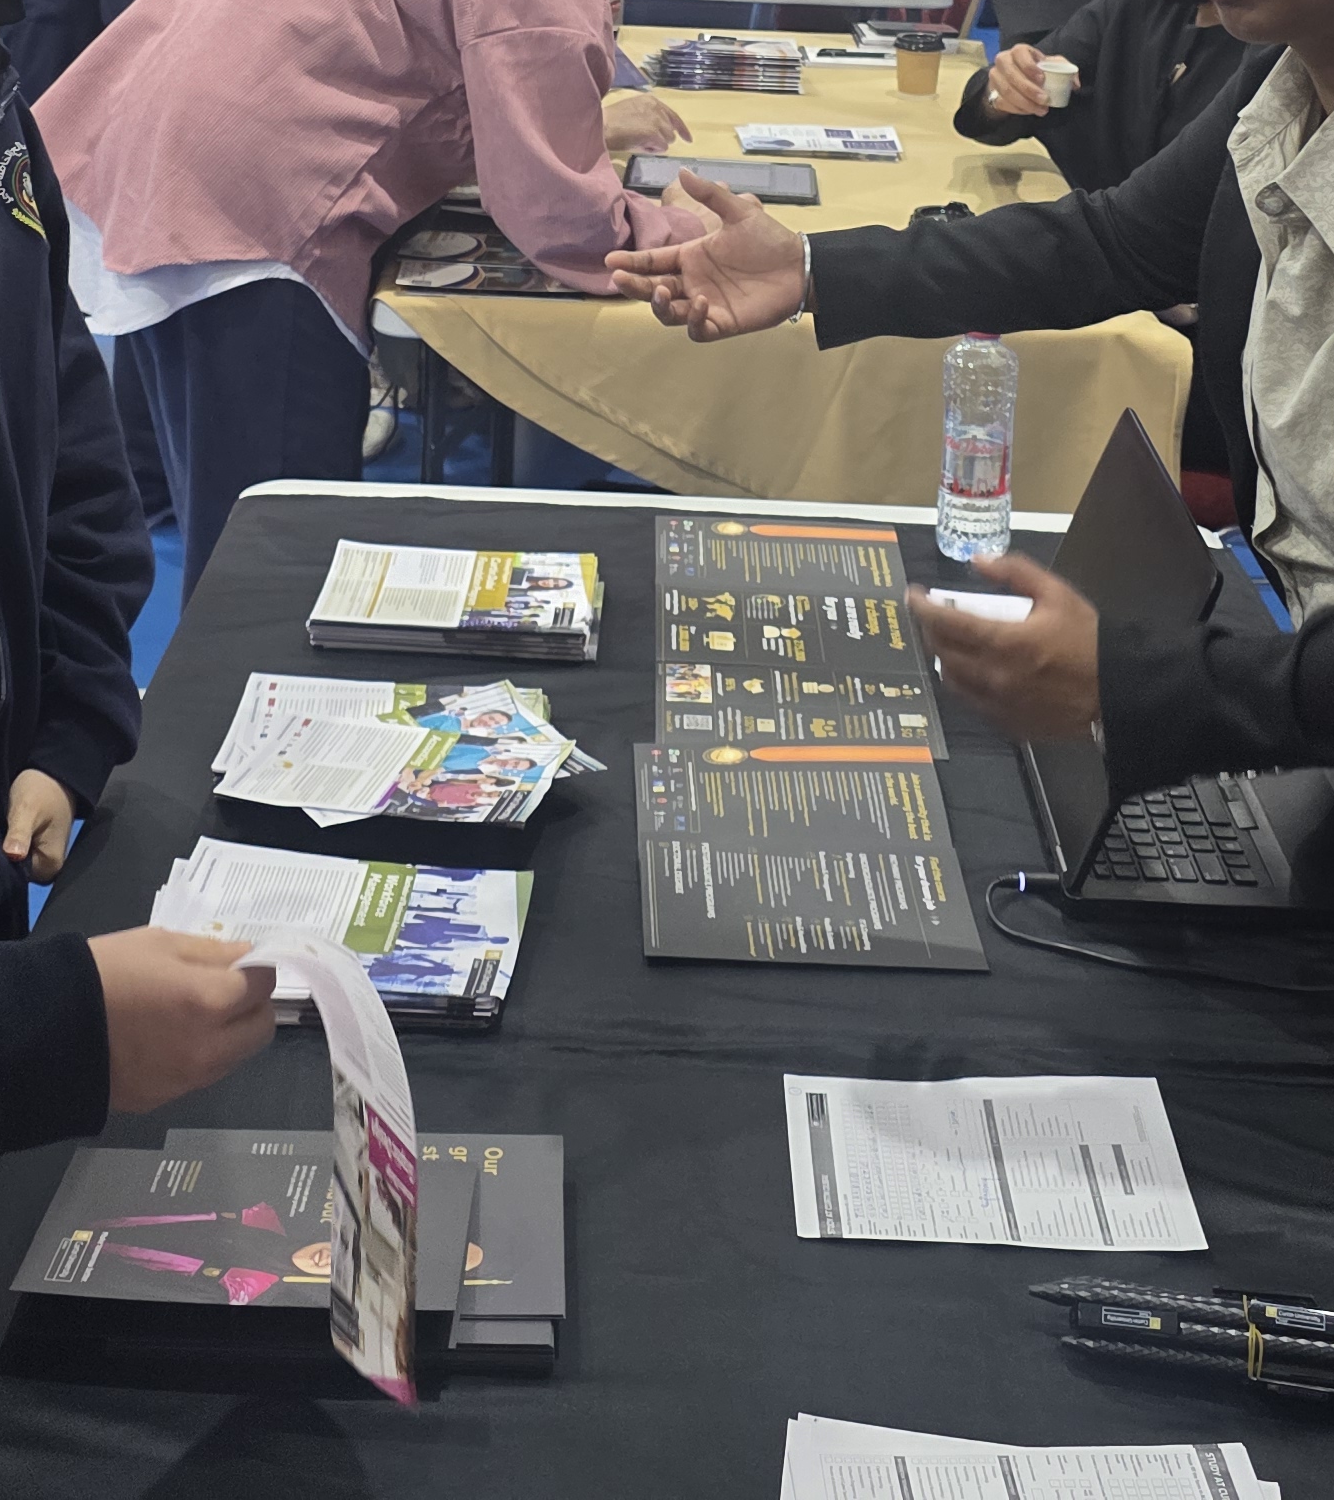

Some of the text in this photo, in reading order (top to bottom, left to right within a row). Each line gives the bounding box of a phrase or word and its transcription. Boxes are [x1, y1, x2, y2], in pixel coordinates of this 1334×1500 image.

[353, 873, 383, 927] Management
[374, 874, 400, 918] Workforce
[483, 1146, 504, 1176] Our
[1205, 1452, 1230, 1500] STUDY AT CU
